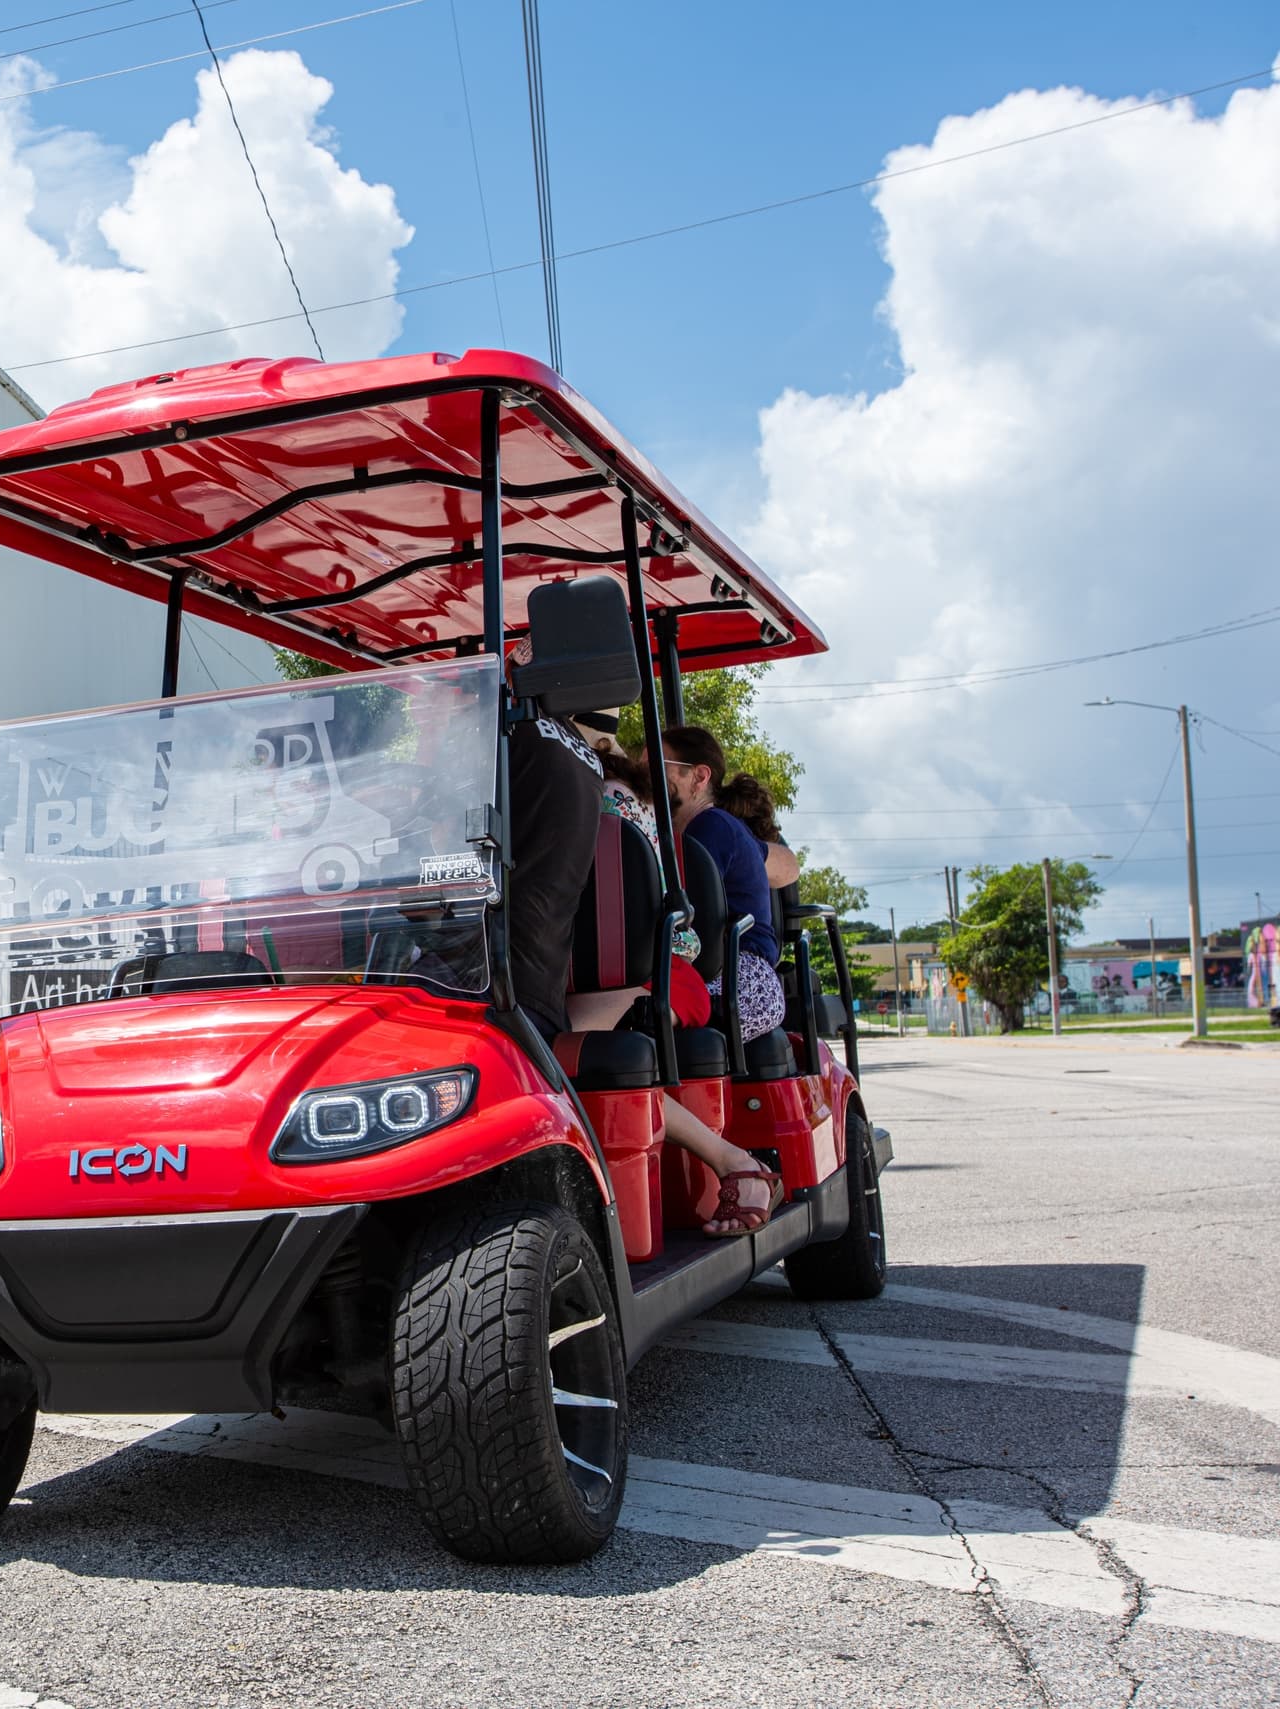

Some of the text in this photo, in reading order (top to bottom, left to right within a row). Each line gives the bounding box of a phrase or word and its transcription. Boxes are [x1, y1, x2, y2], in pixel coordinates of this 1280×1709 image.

[427, 867, 478, 882] BUGGIES
[19, 974, 65, 1013] Art
[69, 1143, 186, 1177] ICON
